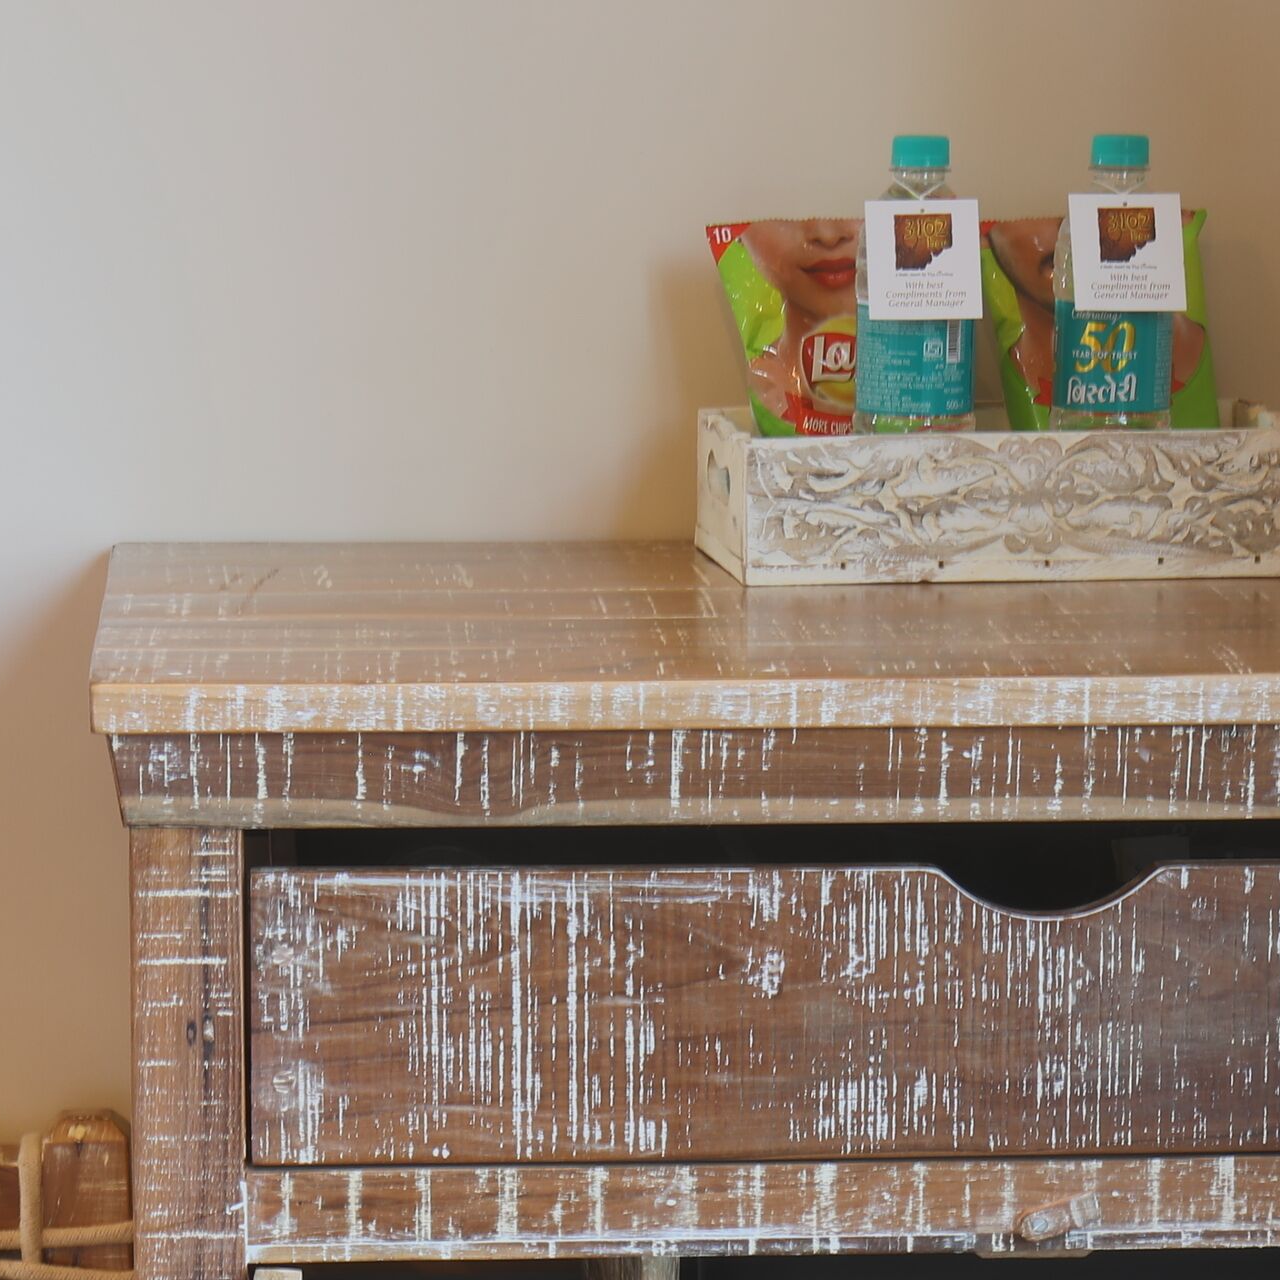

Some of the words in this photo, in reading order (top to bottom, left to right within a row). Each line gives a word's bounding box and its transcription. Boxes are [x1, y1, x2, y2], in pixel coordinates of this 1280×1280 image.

[713, 227, 732, 245] 10
[1110, 273, 1129, 281] With
[1130, 273, 1148, 281] best
[905, 281, 925, 289] With
[926, 280, 944, 289] best
[1091, 282, 1148, 292] Compliments
[1149, 282, 1171, 292] from
[885, 290, 944, 300] Compliments
[945, 290, 967, 300] from
[1094, 291, 1128, 300] General
[1130, 291, 1169, 301] Manager
[888, 299, 923, 308] General
[925, 299, 964, 309] Manager
[1074, 321, 1136, 373] 50
[1072, 349, 1096, 360] YEARS
[1097, 351, 1110, 360] OF
[1111, 351, 1138, 361] TRUST
[802, 415, 829, 435] MORE
